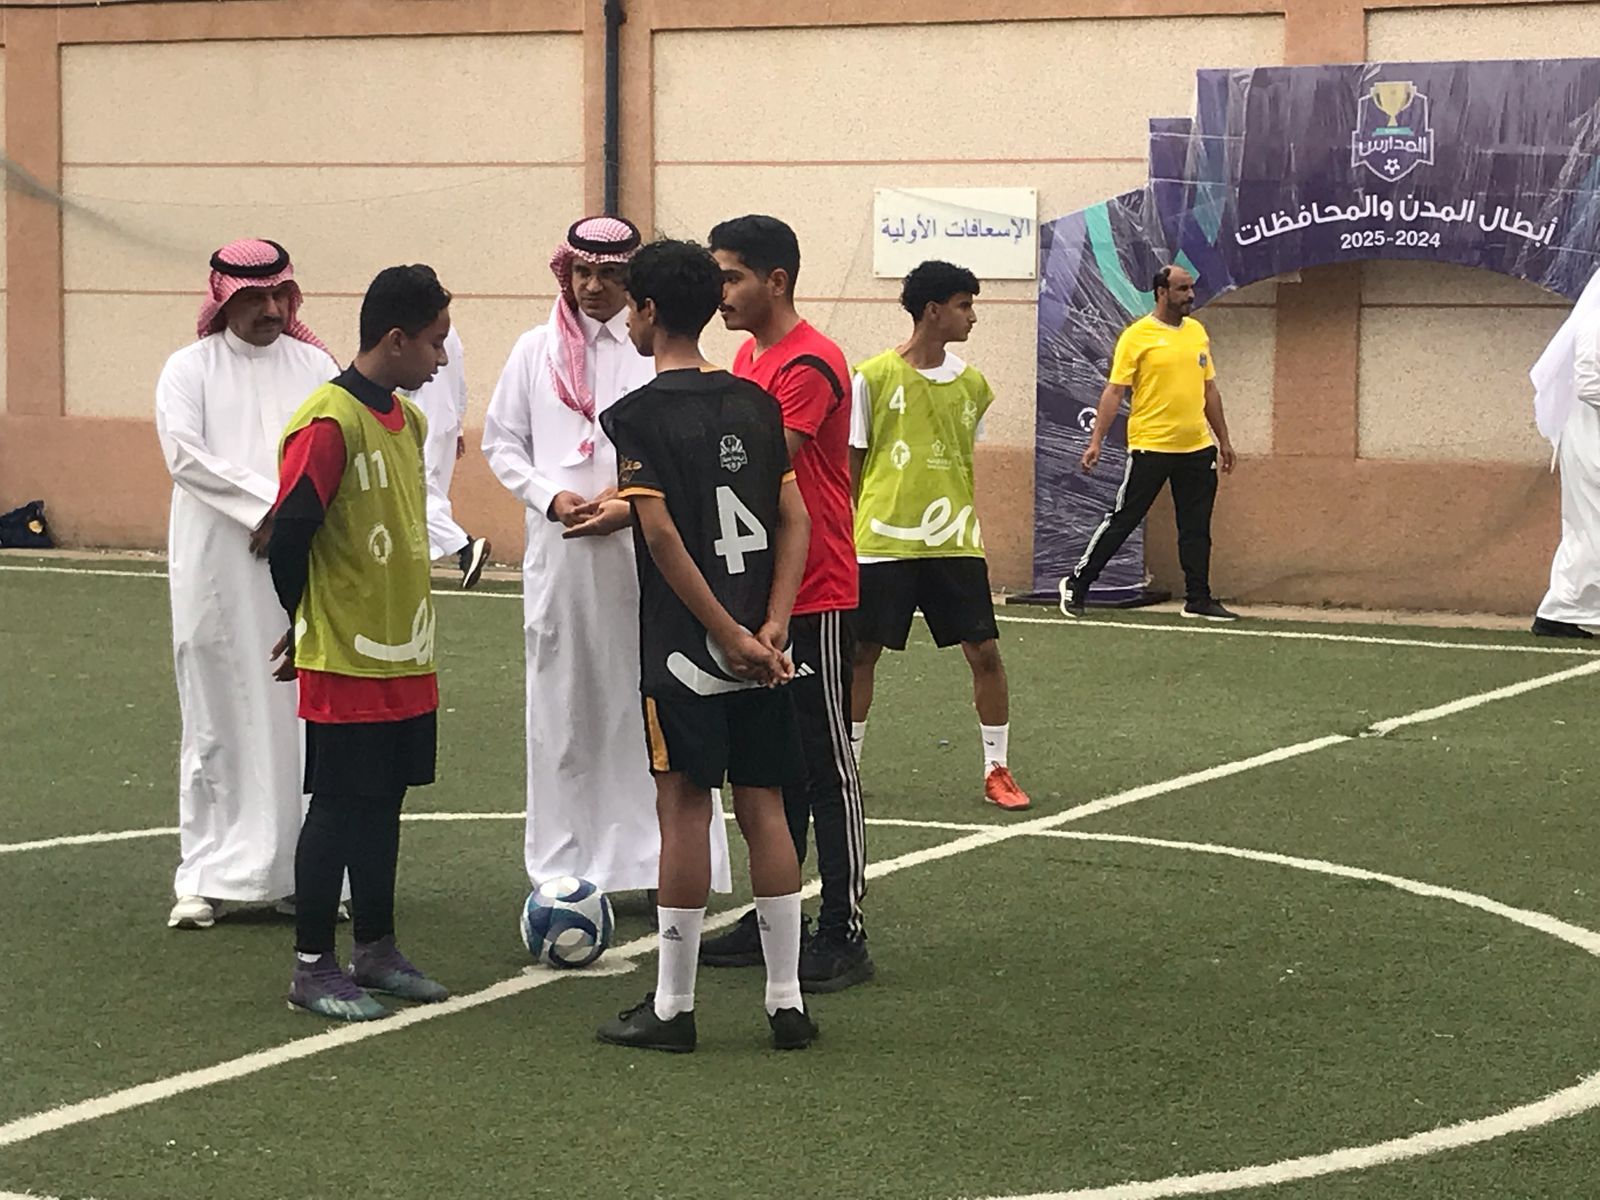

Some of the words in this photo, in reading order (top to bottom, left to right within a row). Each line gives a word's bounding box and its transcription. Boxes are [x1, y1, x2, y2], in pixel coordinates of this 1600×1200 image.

[1359, 136, 1426, 156] المدارس
[1234, 194, 1393, 246] والمحافظات
[1400, 194, 1475, 222] المدن
[881, 213, 937, 243] الأولية
[944, 217, 1030, 244] الإسعافات
[1479, 205, 1558, 247] أبطال
[888, 385, 907, 414] 4
[354, 450, 388, 491] 11
[714, 485, 768, 575] 4
